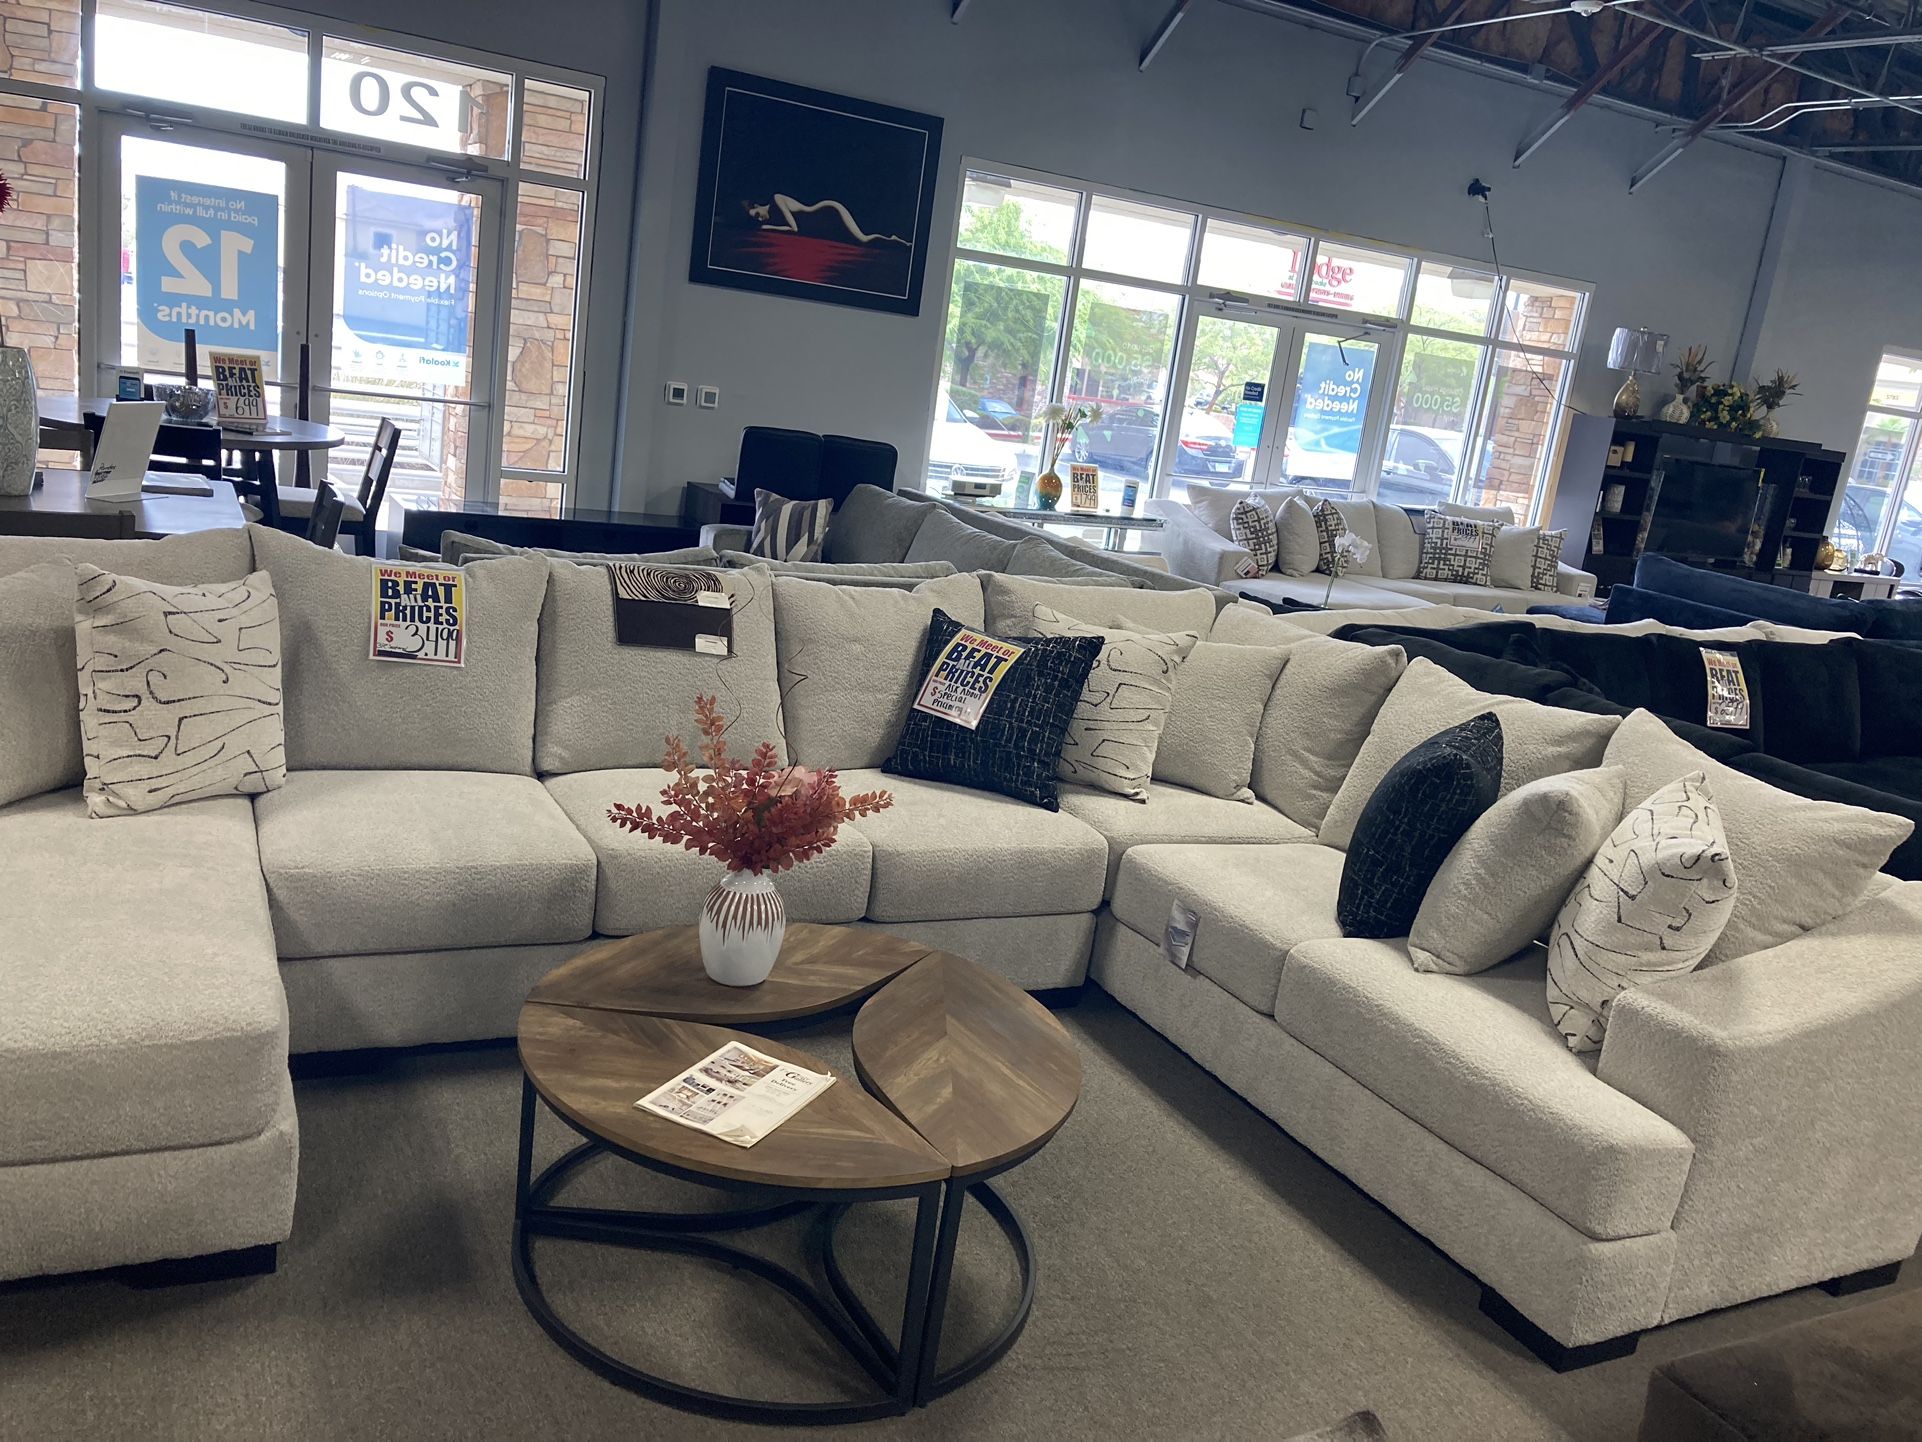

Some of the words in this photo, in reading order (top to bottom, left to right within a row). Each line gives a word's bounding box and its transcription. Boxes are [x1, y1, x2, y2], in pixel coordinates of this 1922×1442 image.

[213, 356, 226, 364] We
[228, 357, 248, 366] Meet
[214, 366, 258, 384] BEAT
[216, 383, 261, 398] PRICES
[236, 398, 258, 416] 699
[1072, 472, 1096, 484] BEAT
[1072, 484, 1096, 494] PRICES
[1452, 526, 1479, 536] PRICES
[380, 569, 402, 578] We
[406, 570, 440, 581] Meet
[380, 578, 458, 604] BEAT
[400, 594, 425, 606] ALL
[380, 600, 458, 627] PRICES
[960, 634, 975, 644] We
[976, 640, 1002, 653] Meet
[1002, 648, 1015, 658] or
[945, 642, 1008, 676] BEAT
[956, 658, 974, 672] ALL
[934, 660, 994, 694] PRICES
[1710, 668, 1740, 686] BEAT
[944, 684, 960, 694] ASK
[960, 688, 982, 700] About
